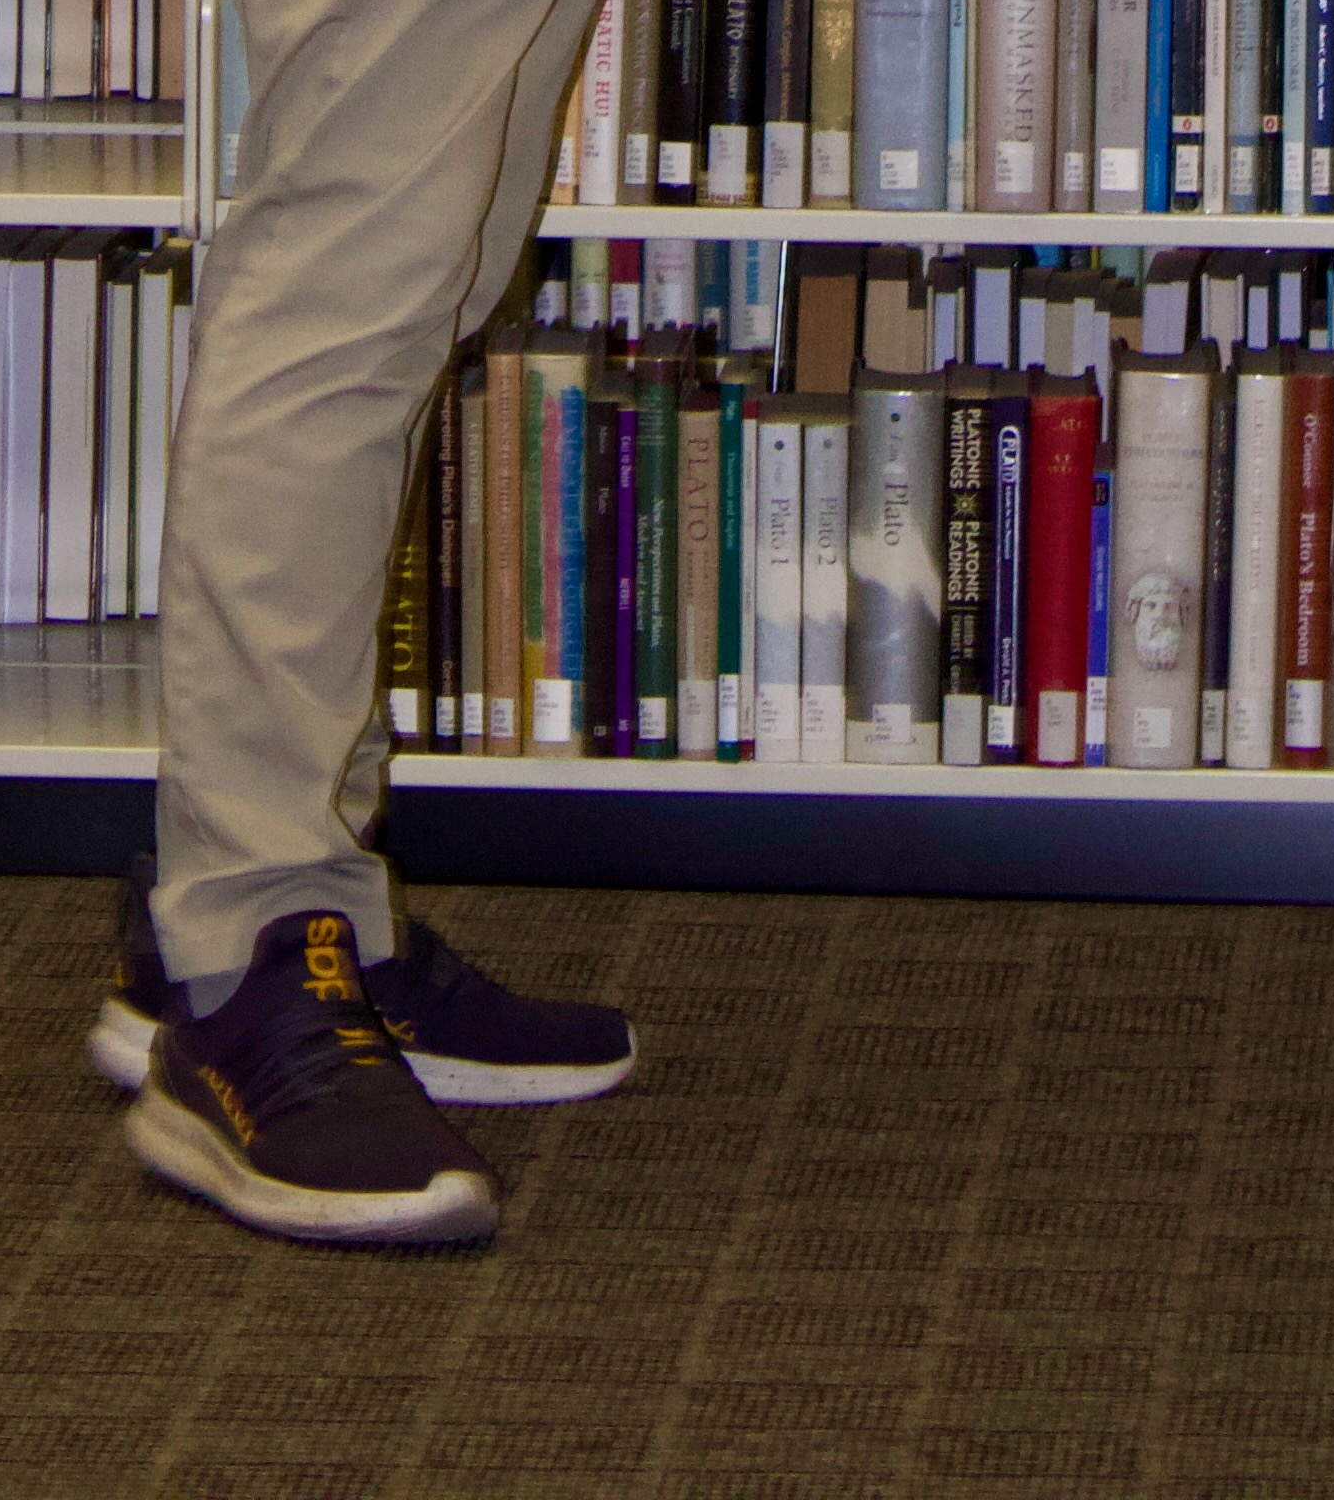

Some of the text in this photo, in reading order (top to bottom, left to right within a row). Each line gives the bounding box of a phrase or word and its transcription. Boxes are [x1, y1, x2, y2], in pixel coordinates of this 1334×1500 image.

[950, 409, 966, 489] WRITINGS
[965, 409, 980, 489] PLATONIC
[1003, 436, 1017, 483] PLATO
[440, 466, 454, 587] Plato's Dialogues
[688, 438, 711, 542] PLATO
[882, 482, 909, 547] Plato
[770, 498, 791, 565] Plato 1
[819, 497, 839, 566] Plato 2
[948, 521, 964, 601] READINGS
[964, 521, 980, 601] PLATONIC
[1297, 413, 1318, 666] O'Connor Plato's Bedroom
